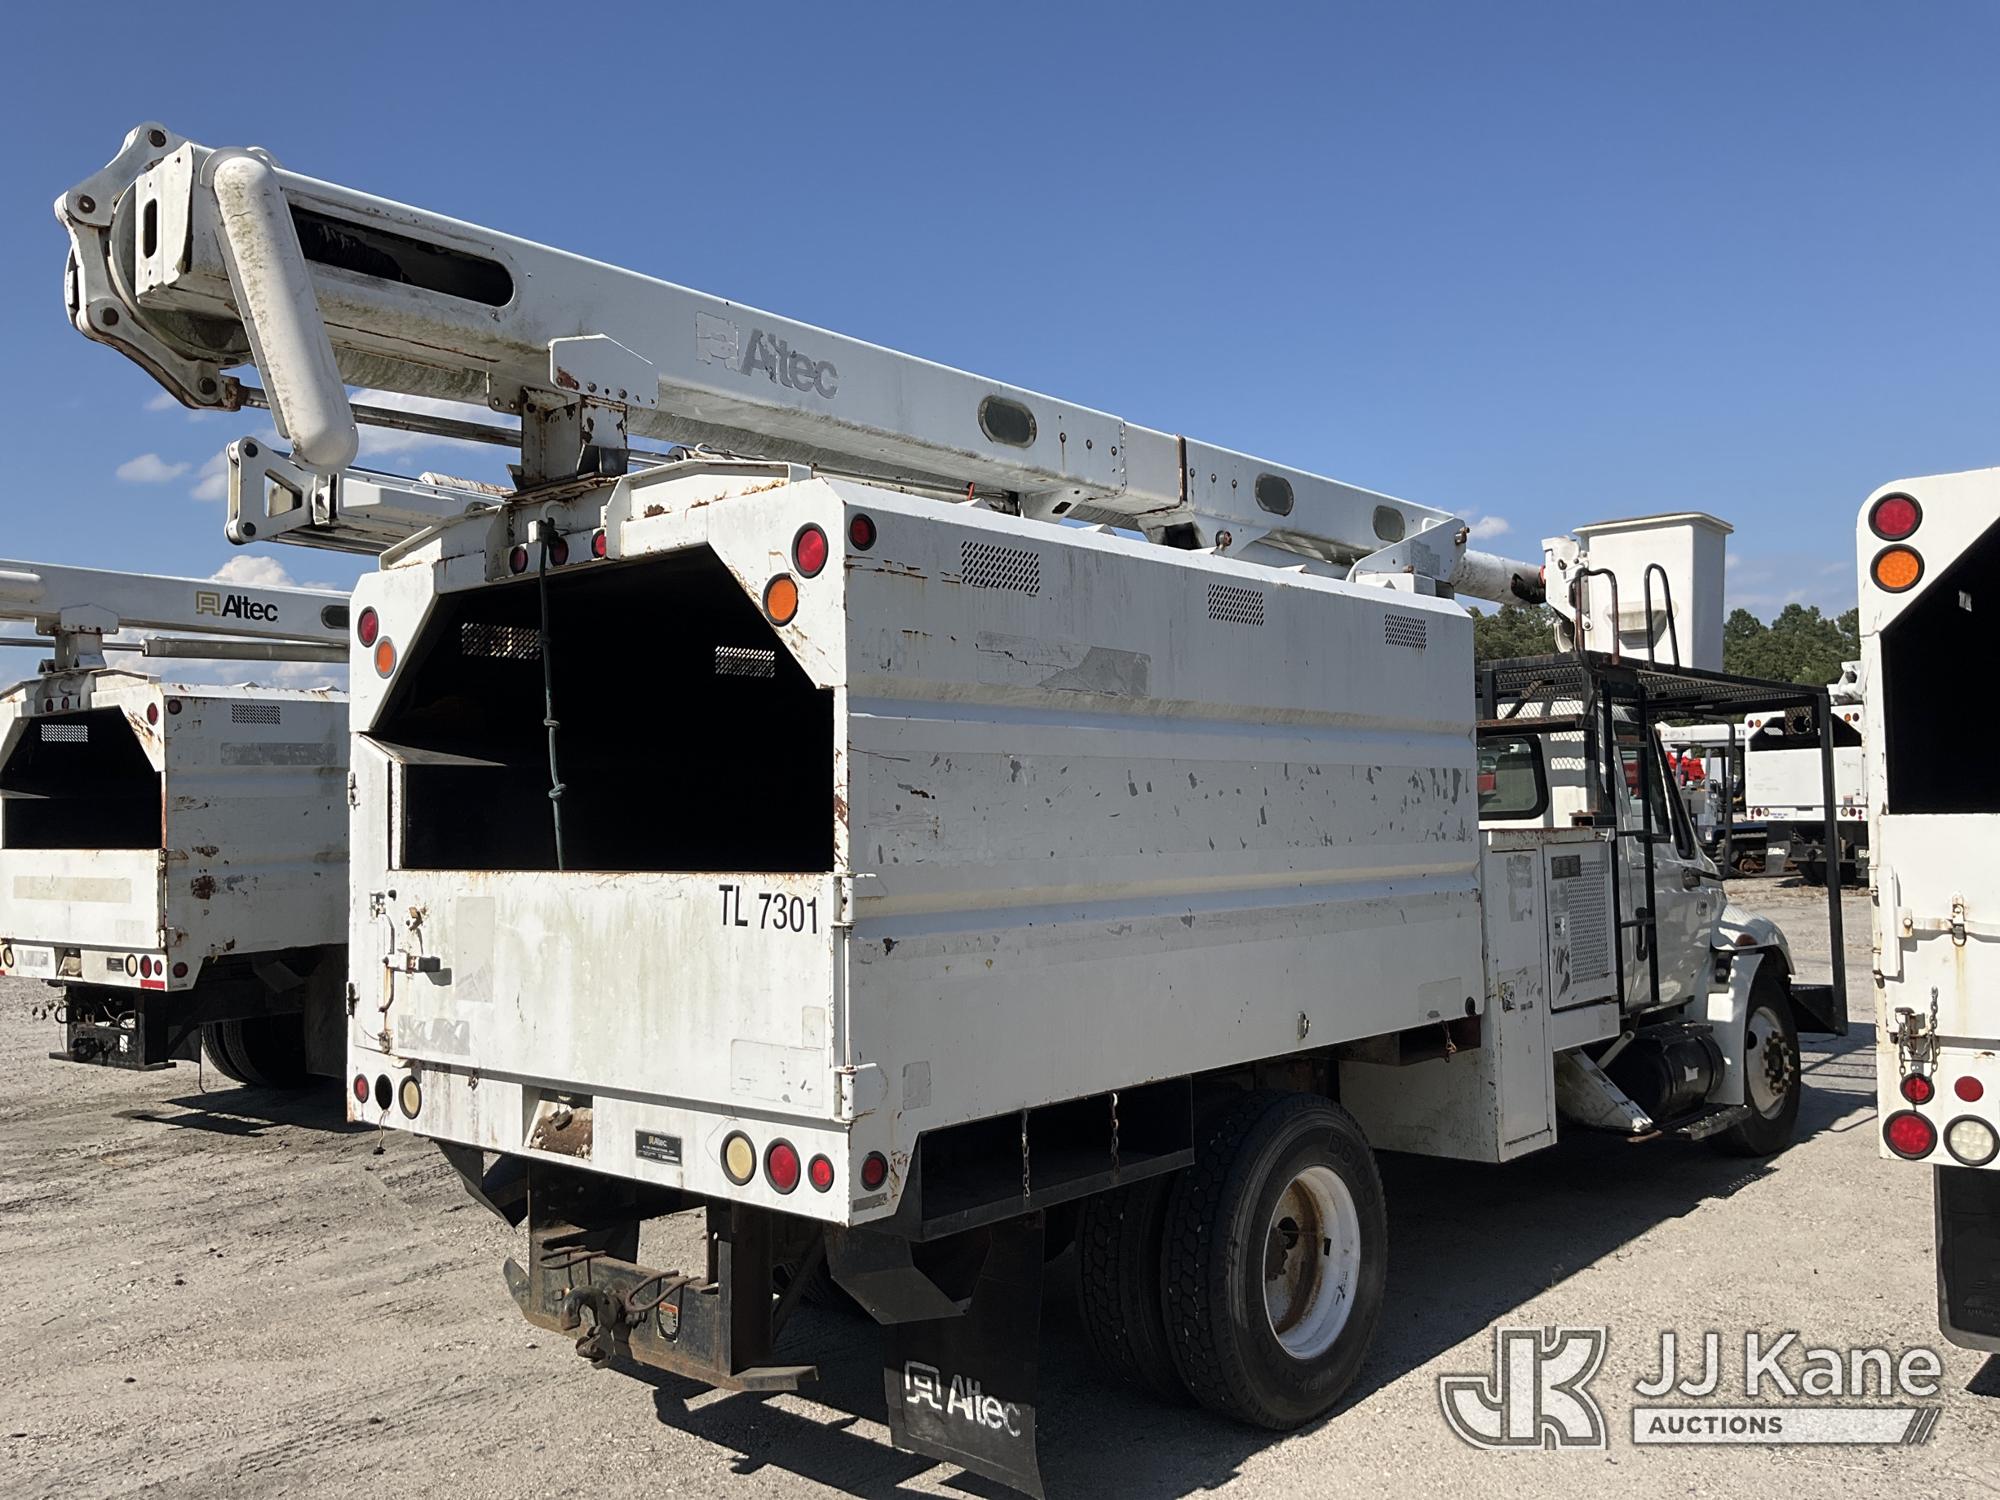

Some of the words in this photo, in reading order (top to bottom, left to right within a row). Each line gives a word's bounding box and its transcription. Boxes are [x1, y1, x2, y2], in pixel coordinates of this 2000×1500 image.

[740, 328, 840, 399] Altec
[221, 594, 278, 622] Altec
[718, 884, 748, 927] TL
[758, 893, 817, 934] 7301
[946, 1374, 1021, 1437] Altec
